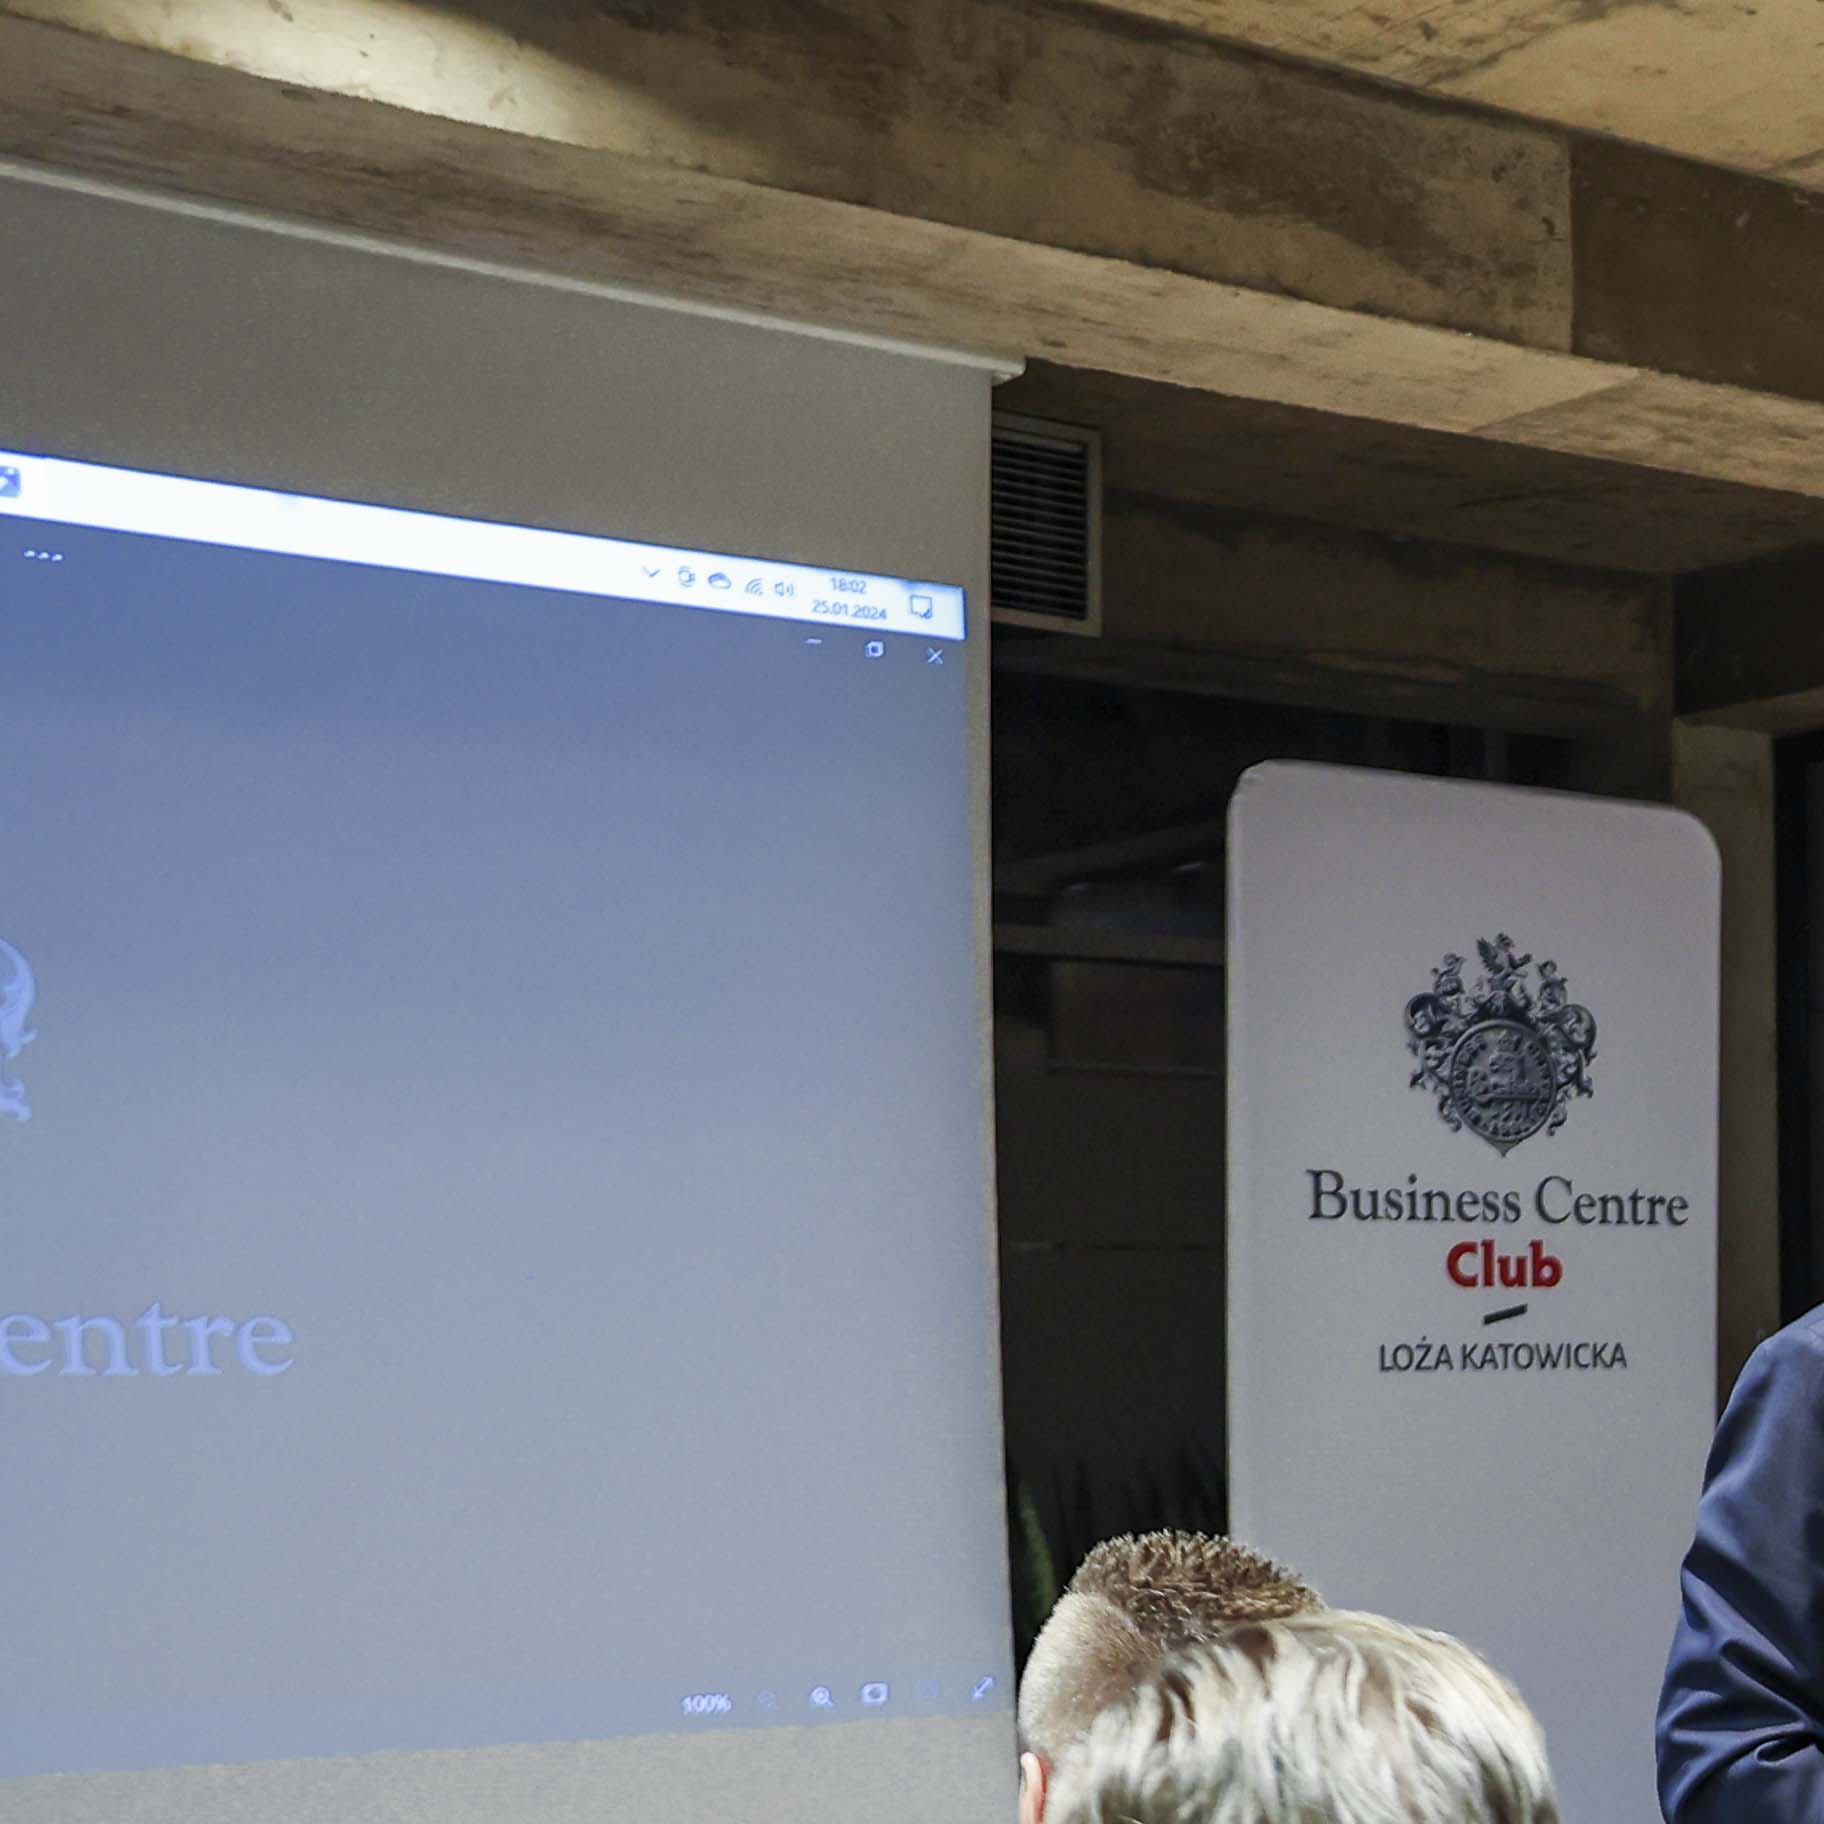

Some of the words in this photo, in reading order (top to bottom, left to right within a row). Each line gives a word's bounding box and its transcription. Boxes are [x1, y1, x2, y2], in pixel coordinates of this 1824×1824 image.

[830, 577, 867, 594] 18:02
[812, 600, 888, 620] 25.01.2024
[1306, 1169, 1521, 1223] Business
[1535, 1176, 1689, 1226] Centre
[1447, 1240, 1563, 1288] Club
[1379, 1335, 1453, 1372] LOŻA
[1462, 1342, 1628, 1370] KATOWICKA
[682, 1694, 732, 1713] 100%
